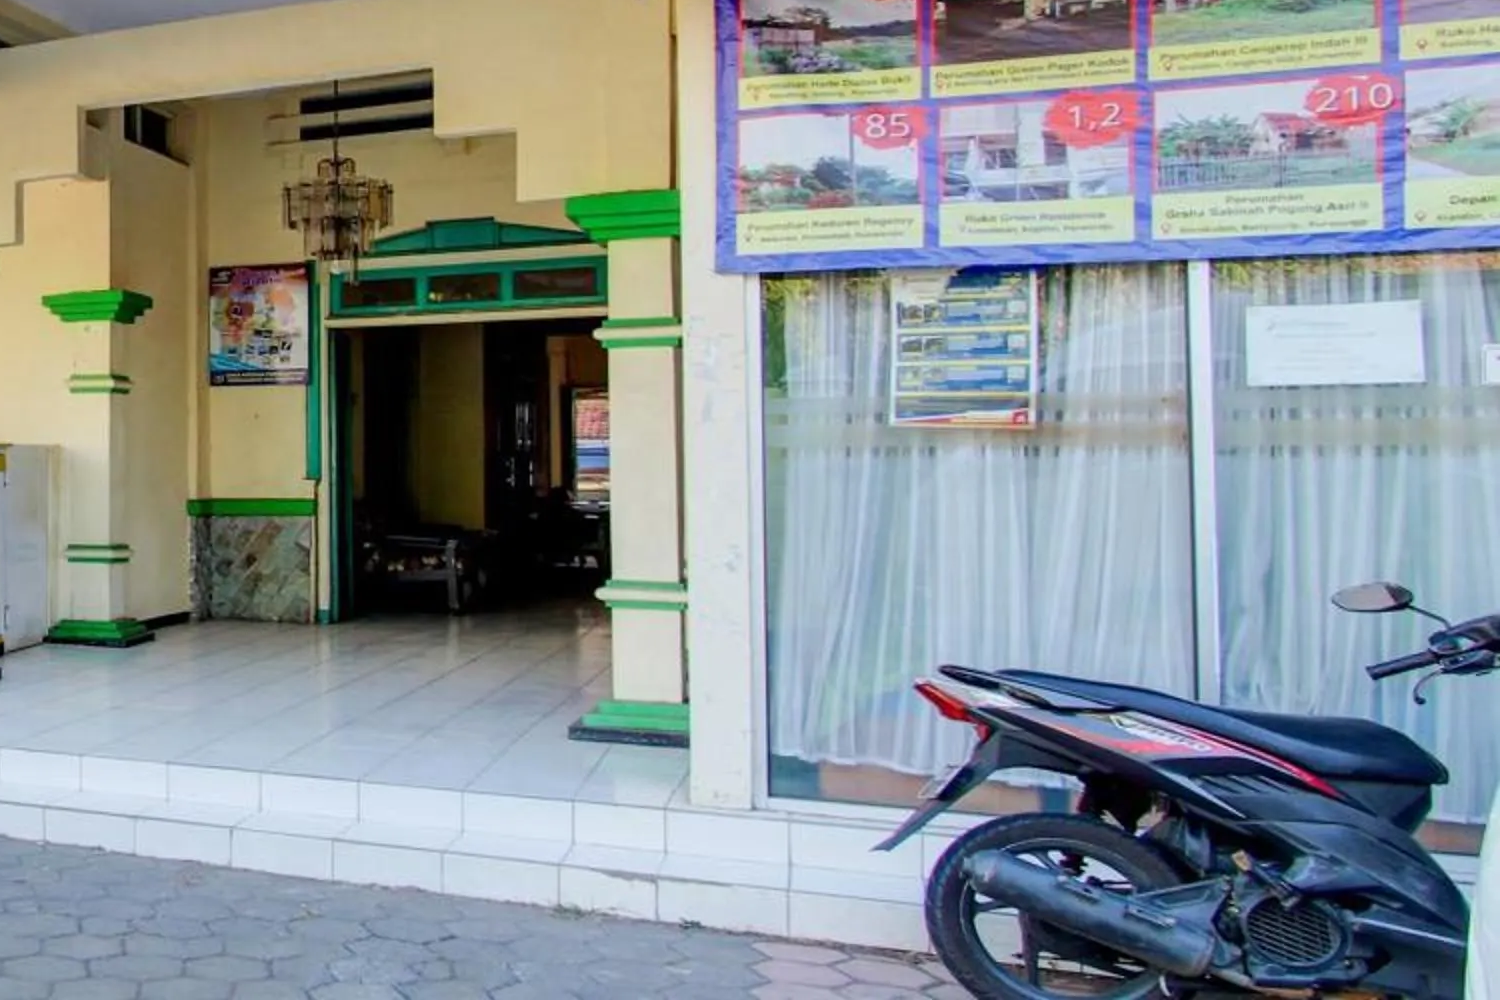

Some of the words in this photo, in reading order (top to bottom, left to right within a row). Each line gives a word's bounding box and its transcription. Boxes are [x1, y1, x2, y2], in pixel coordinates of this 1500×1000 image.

[1315, 83, 1393, 113] 210
[865, 112, 911, 139] 85
[1068, 102, 1122, 131] 1,2
